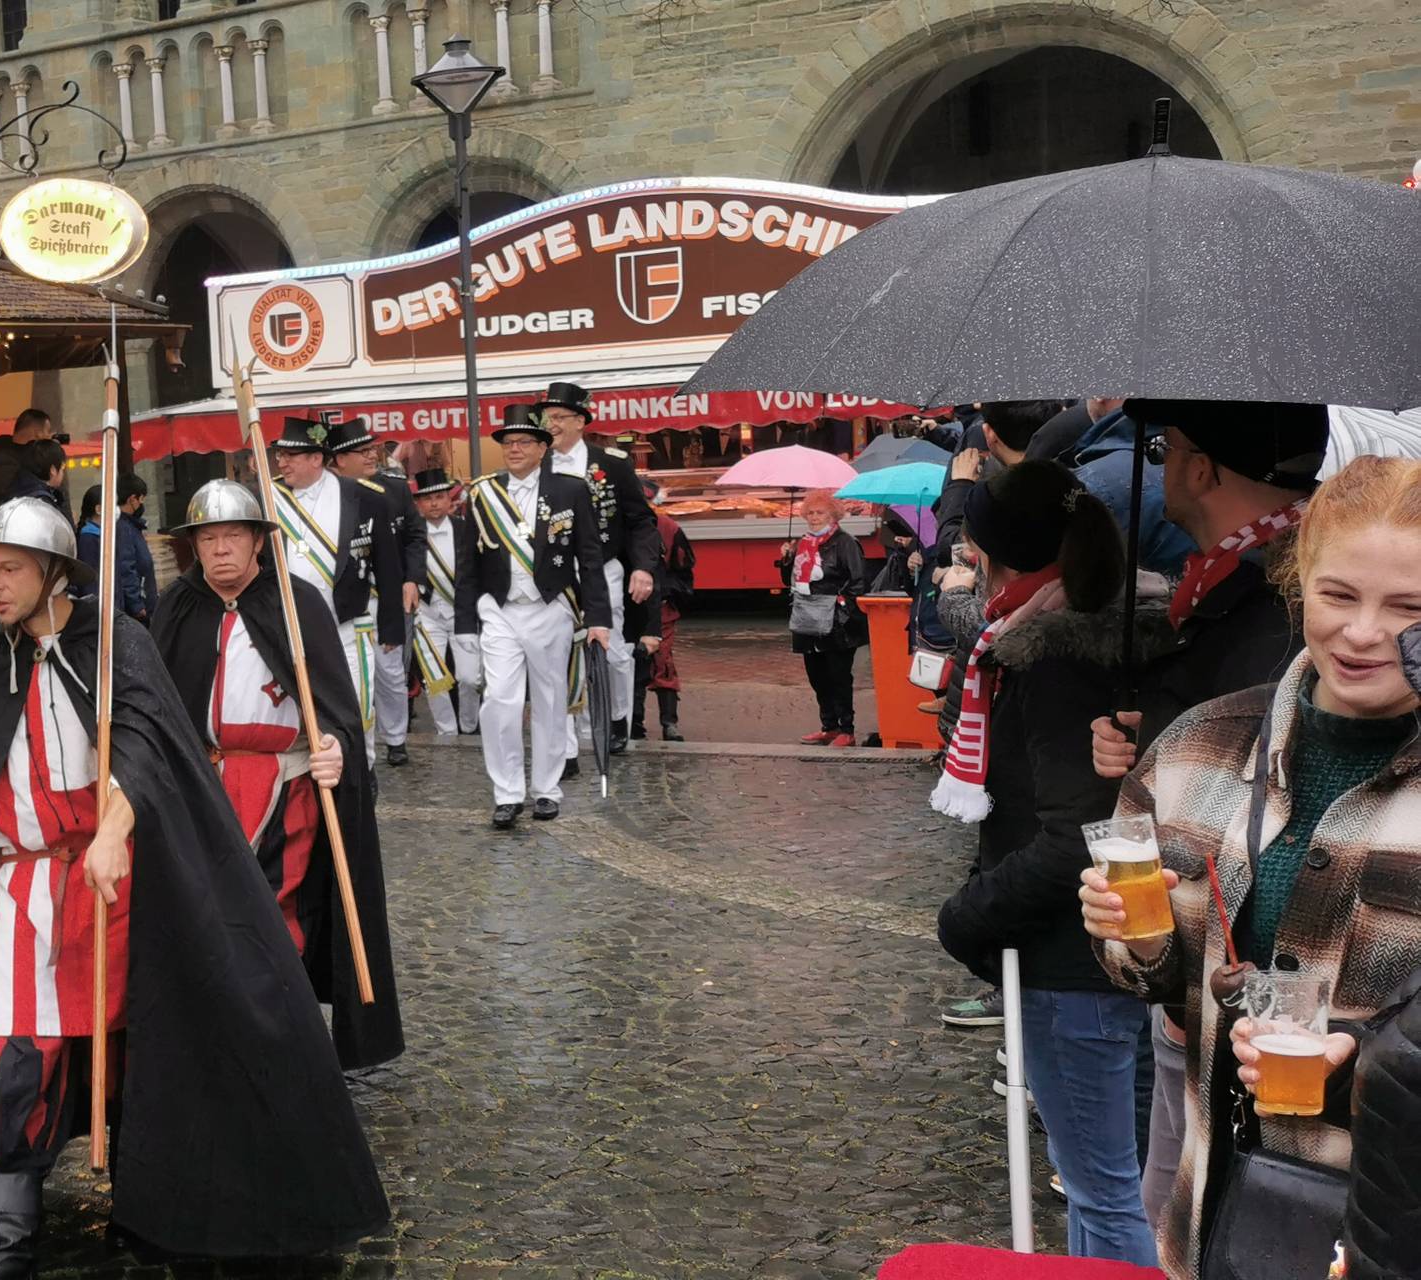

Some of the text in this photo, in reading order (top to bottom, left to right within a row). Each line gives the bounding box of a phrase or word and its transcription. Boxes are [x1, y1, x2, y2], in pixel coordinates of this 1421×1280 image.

[29, 236, 109, 256] Spießbraten
[372, 281, 459, 334] DER
[467, 220, 578, 298] GUTE
[296, 291, 316, 312] VON
[460, 308, 594, 338] LUDGER
[253, 320, 320, 368] LUDGER FISCHER
[357, 411, 405, 433] DER
[756, 391, 814, 410] VON
